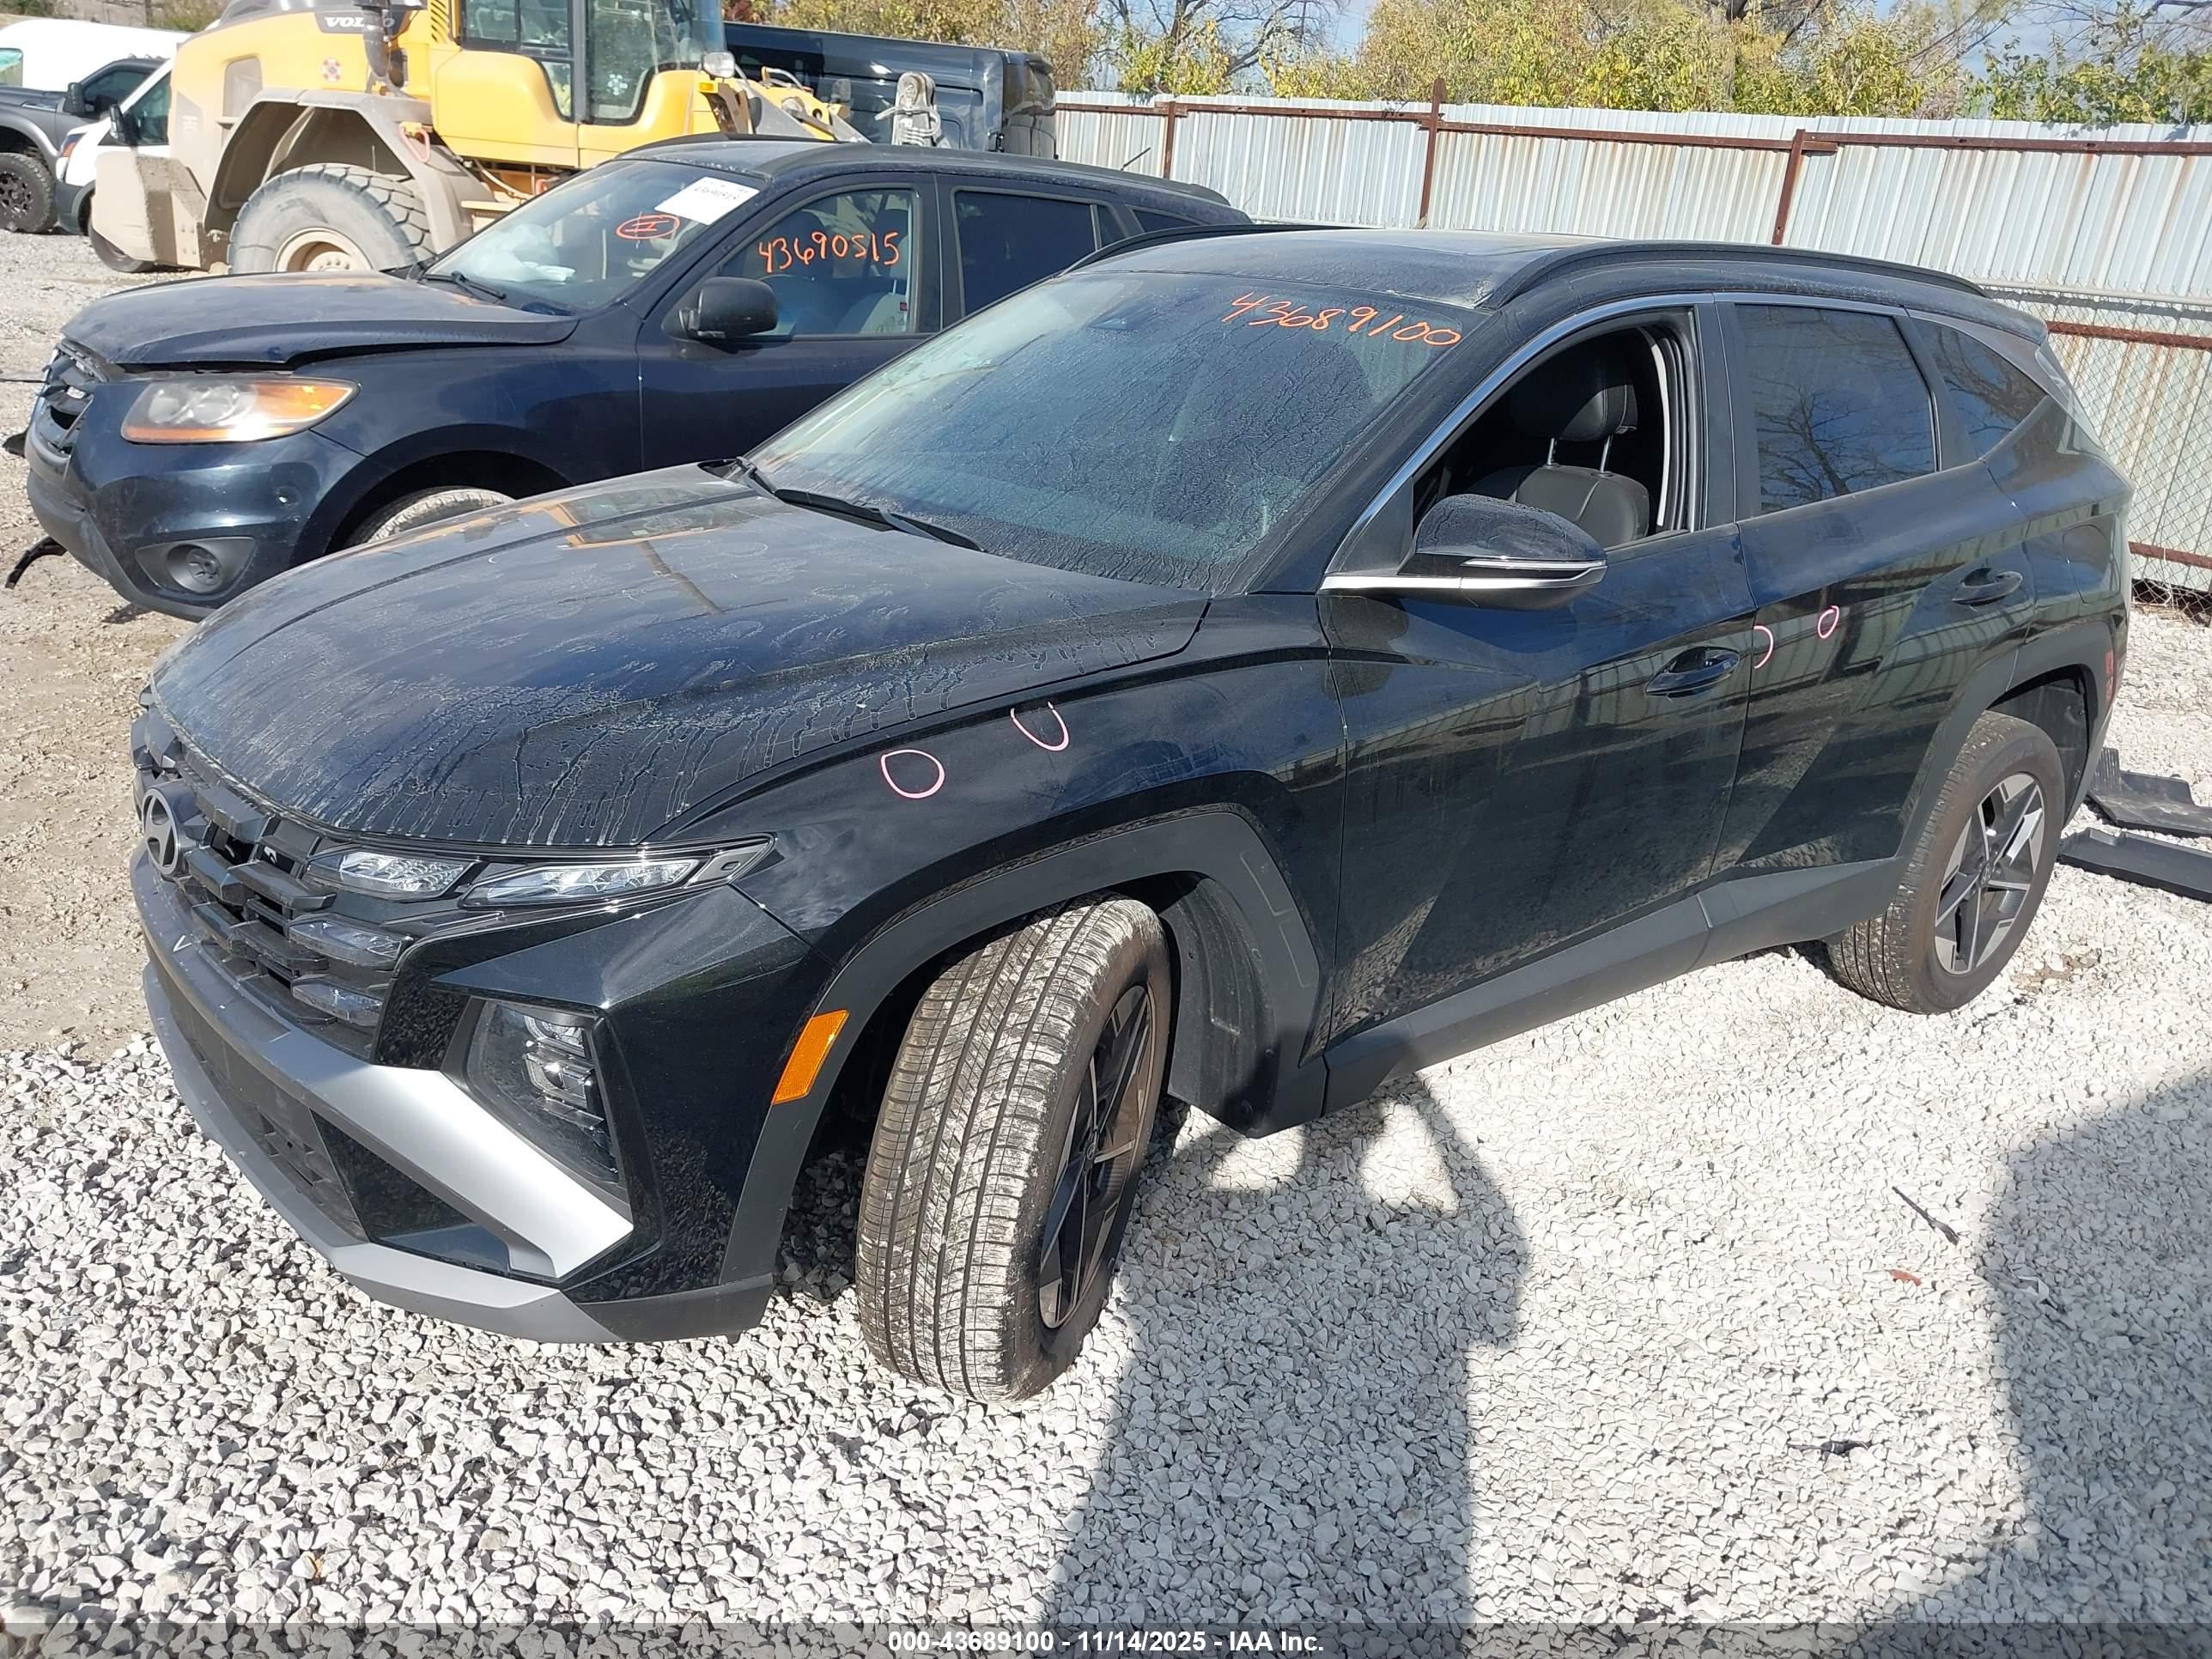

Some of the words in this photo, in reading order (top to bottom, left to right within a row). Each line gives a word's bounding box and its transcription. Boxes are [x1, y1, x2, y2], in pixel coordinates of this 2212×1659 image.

[325, 16, 395, 27] VOLO
[758, 231, 900, 273] 43690515
[1221, 290, 1462, 345] 43689100
